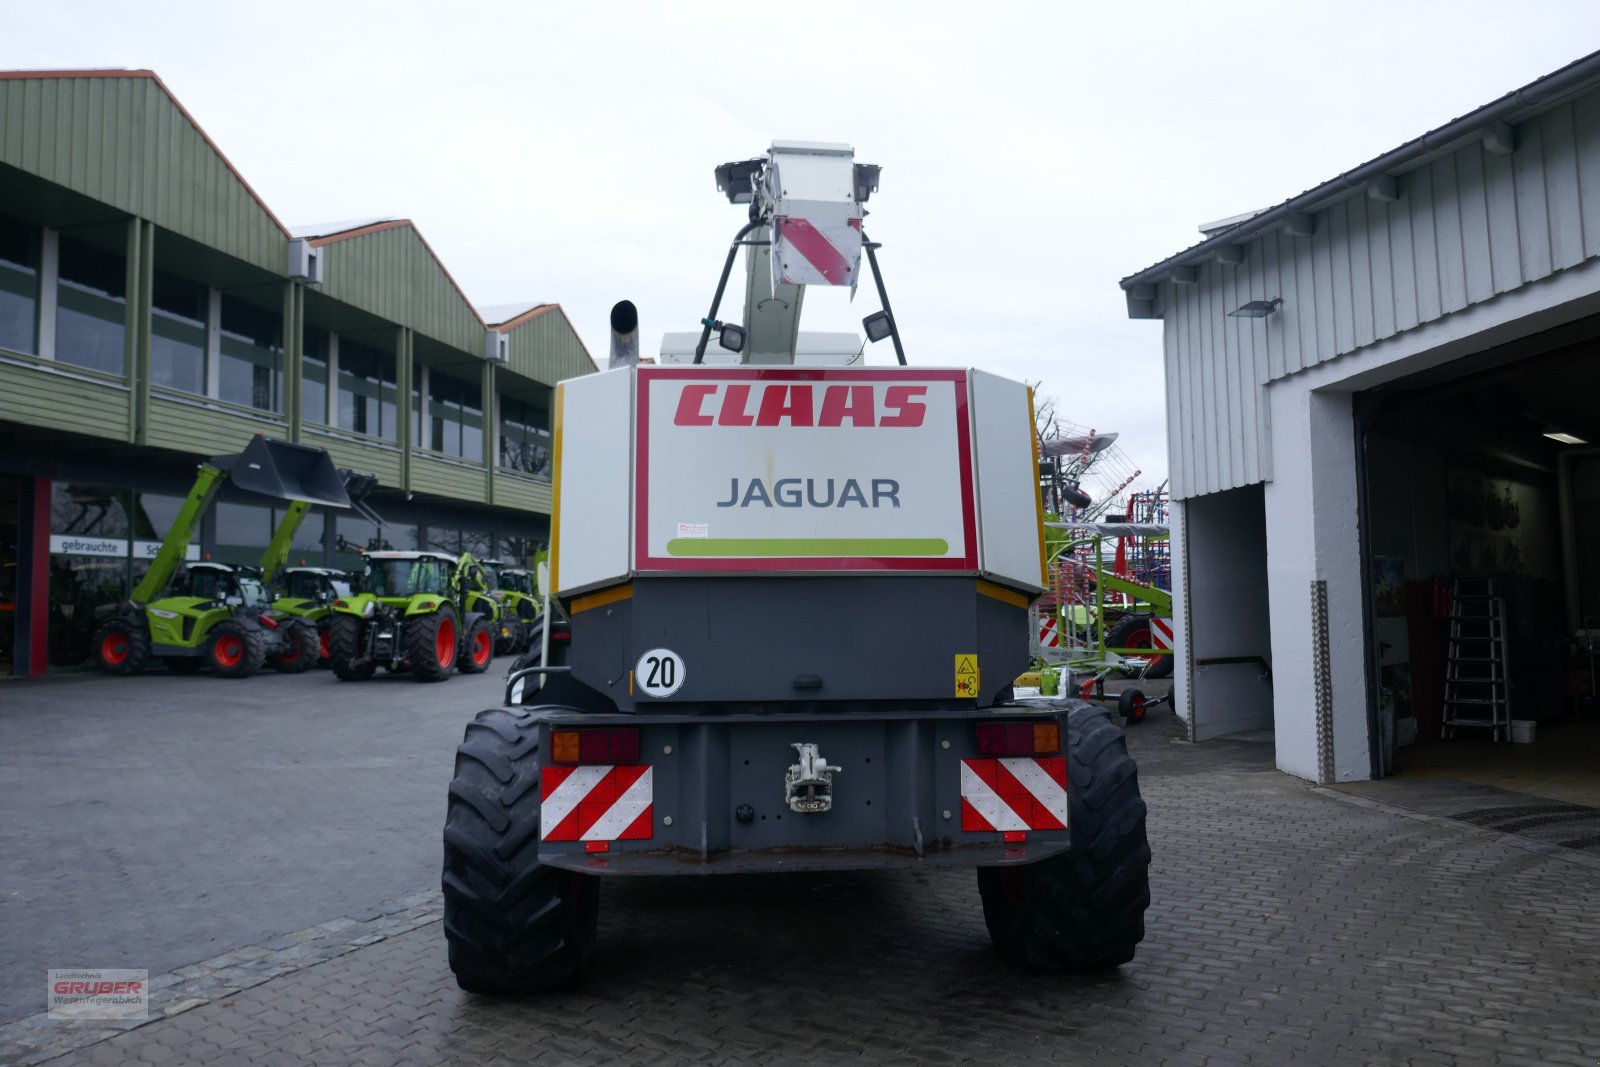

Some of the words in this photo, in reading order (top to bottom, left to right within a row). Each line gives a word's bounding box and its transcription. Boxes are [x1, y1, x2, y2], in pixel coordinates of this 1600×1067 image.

[673, 384, 928, 428] CLAAS
[716, 478, 901, 508] JAGUAR
[62, 540, 118, 553] gebrauchte
[646, 656, 675, 688] 20
